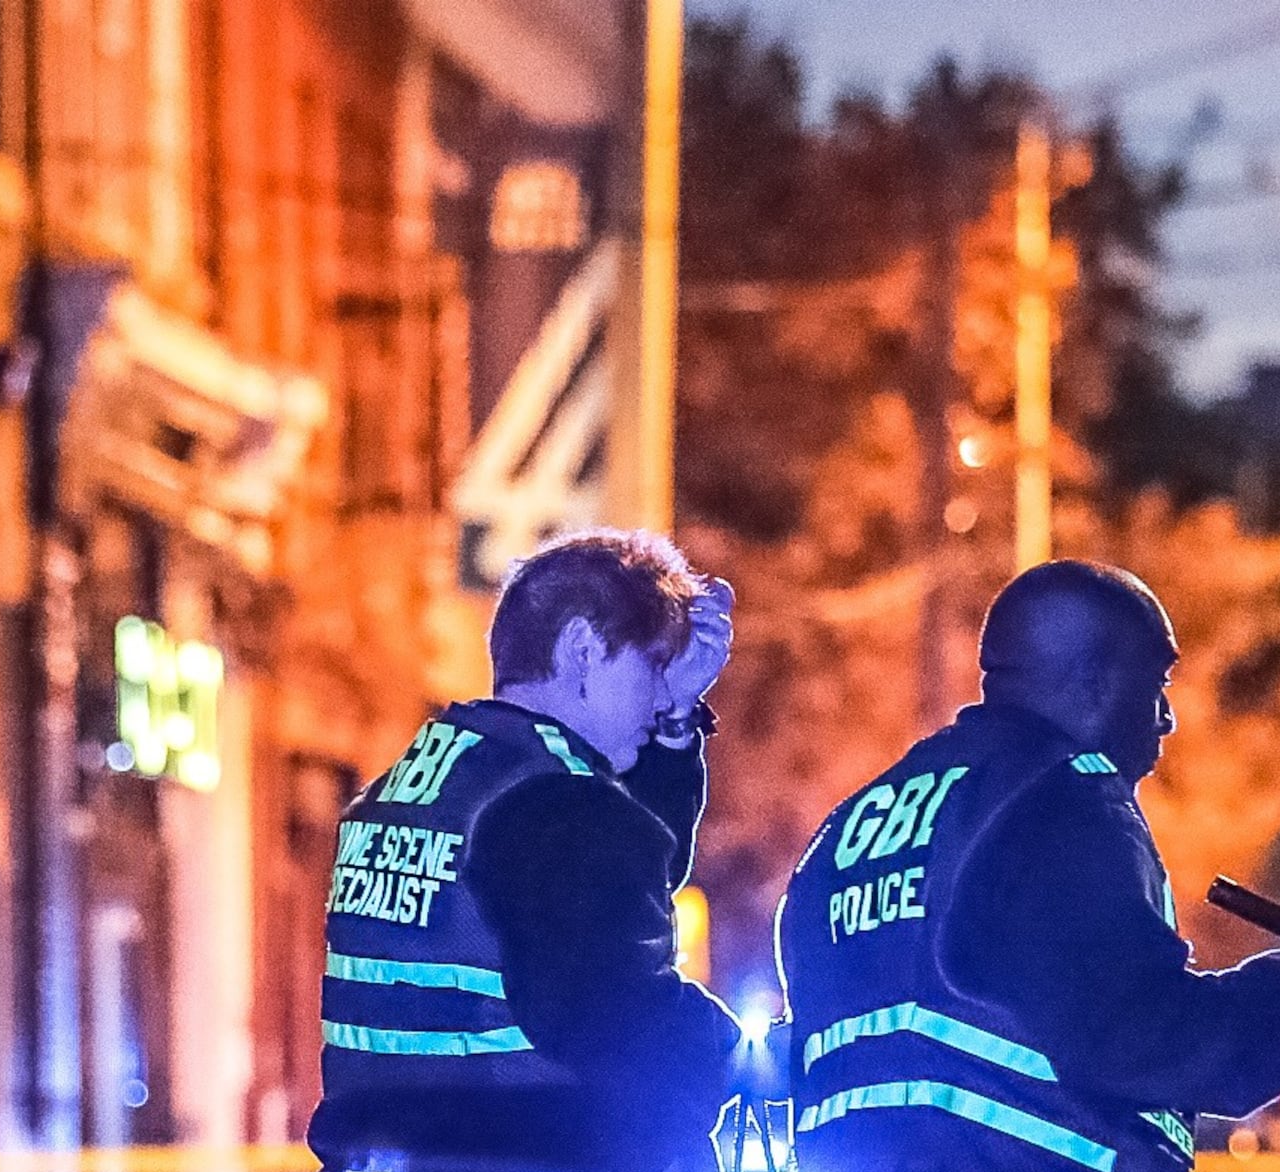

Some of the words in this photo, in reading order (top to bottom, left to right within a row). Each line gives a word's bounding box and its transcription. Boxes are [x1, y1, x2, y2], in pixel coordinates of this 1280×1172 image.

[374, 825, 464, 882] SCENE
[833, 766, 970, 871] GBI
[829, 866, 926, 944] POLICE
